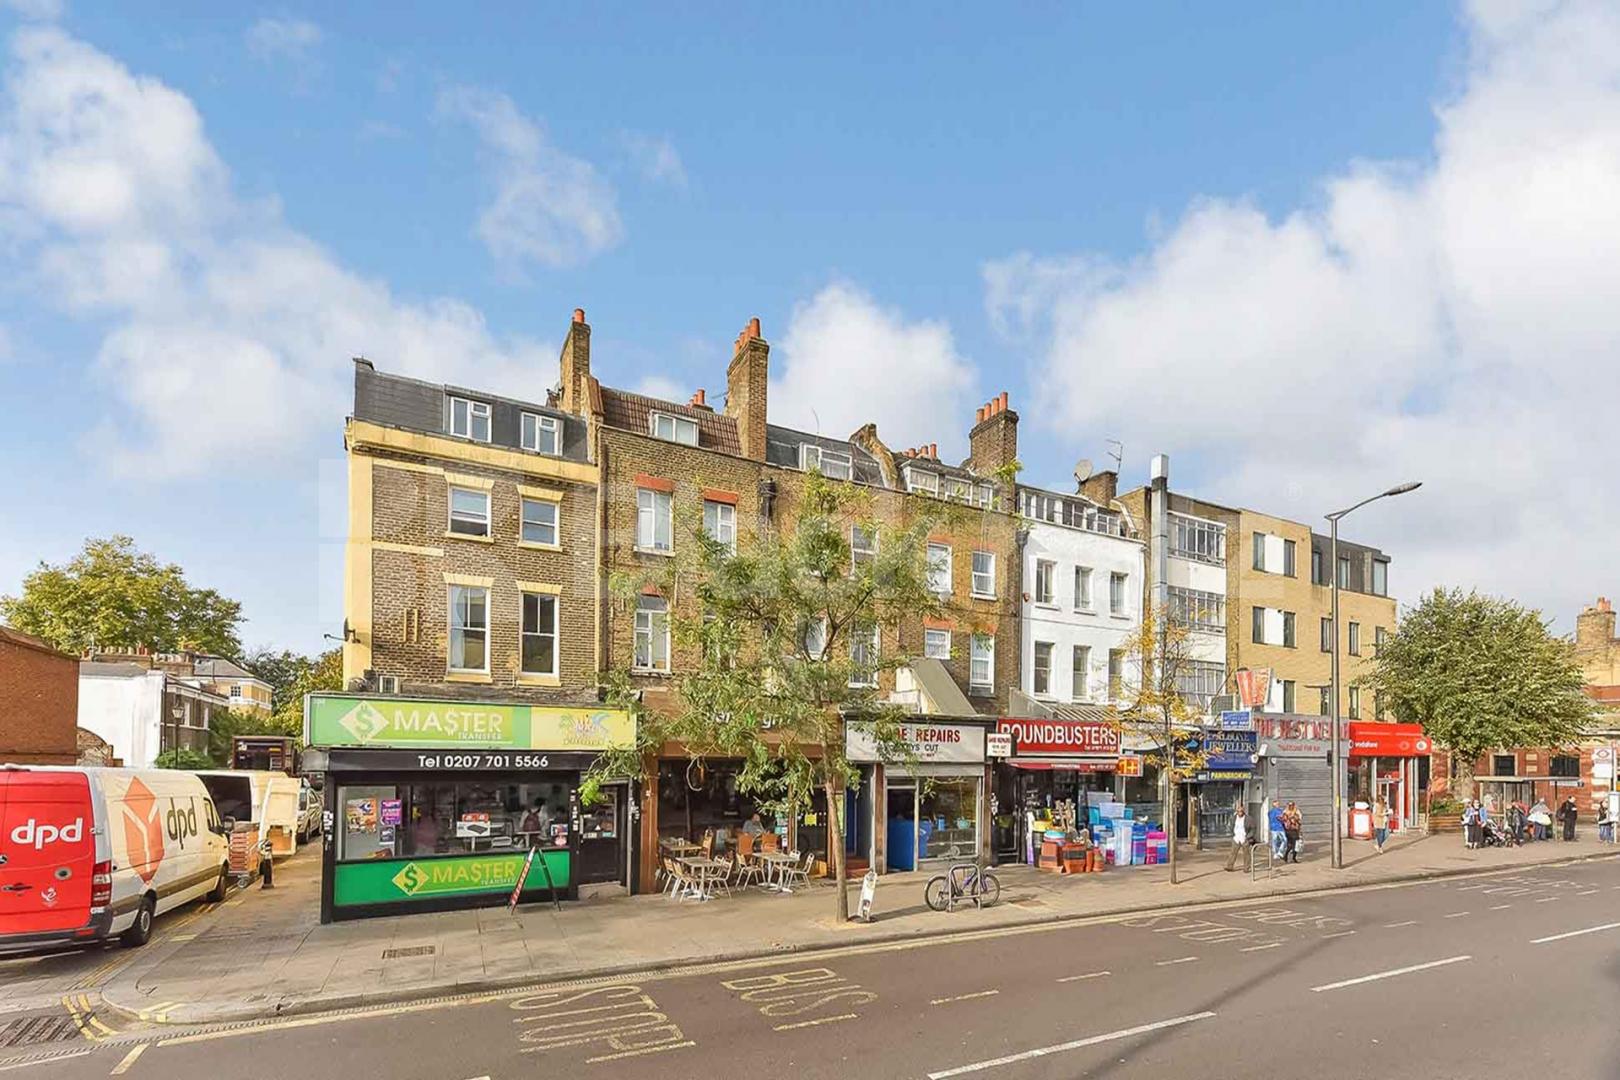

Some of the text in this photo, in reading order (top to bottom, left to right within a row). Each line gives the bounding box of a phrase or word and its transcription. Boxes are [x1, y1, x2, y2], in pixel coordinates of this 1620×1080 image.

[916, 728, 961, 743] REPAIRS
[924, 744, 939, 752] CUT
[418, 755, 549, 768] Tel 0207 701 5566
[166, 797, 197, 850] dpd
[11, 818, 83, 850] dpd
